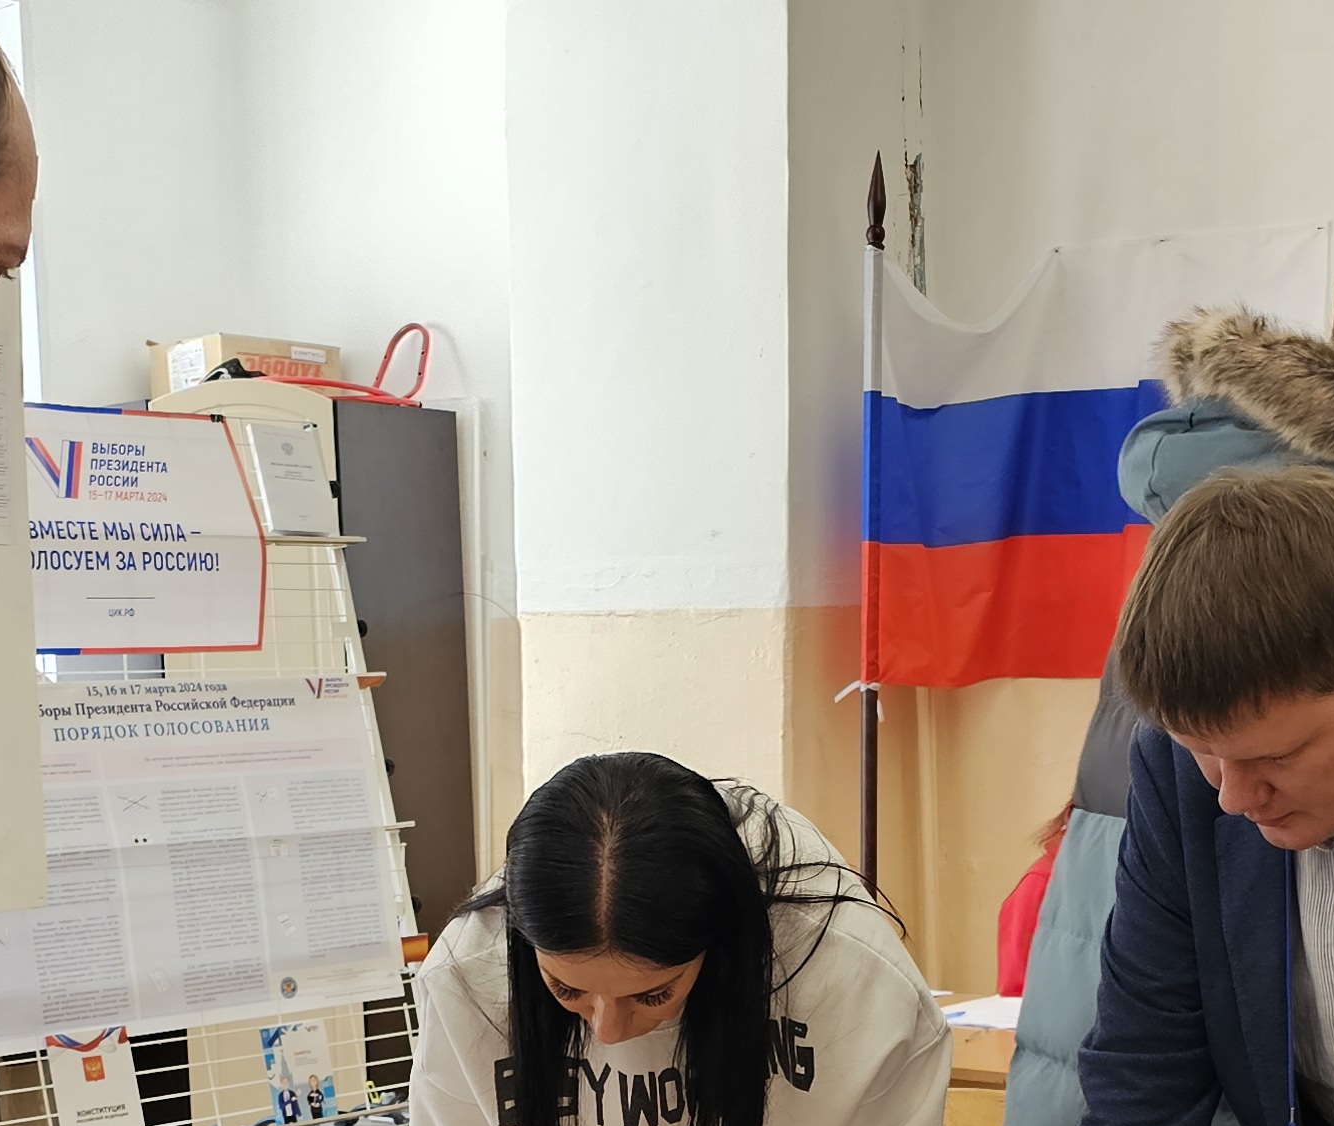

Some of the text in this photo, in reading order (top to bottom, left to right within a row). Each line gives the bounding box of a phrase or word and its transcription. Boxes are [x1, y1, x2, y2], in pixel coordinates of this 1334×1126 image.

[91, 442, 145, 456] ВЫБОРЫ
[90, 459, 168, 473] ПРЕЗИДЕНТА
[88, 474, 138, 487] РОССИИ
[115, 491, 145, 501] МАРТА
[147, 492, 168, 502] 2024
[29, 520, 99, 540] ВМЕСТЕ
[103, 522, 135, 541] МЫ
[140, 522, 187, 542] СИЛА
[116, 551, 137, 571] ЗА
[142, 552, 219, 571] РОССИЮ!
[86, 682, 228, 698] 15, 16 и 17 марта 2024 года
[39, 695, 296, 720] боры Президента Российской Федерации
[53, 717, 271, 743] ПОРЯДОК ГОЛОСОВАНИЯ
[76, 1103, 126, 1117] КОНСТИТУЦИЯ
